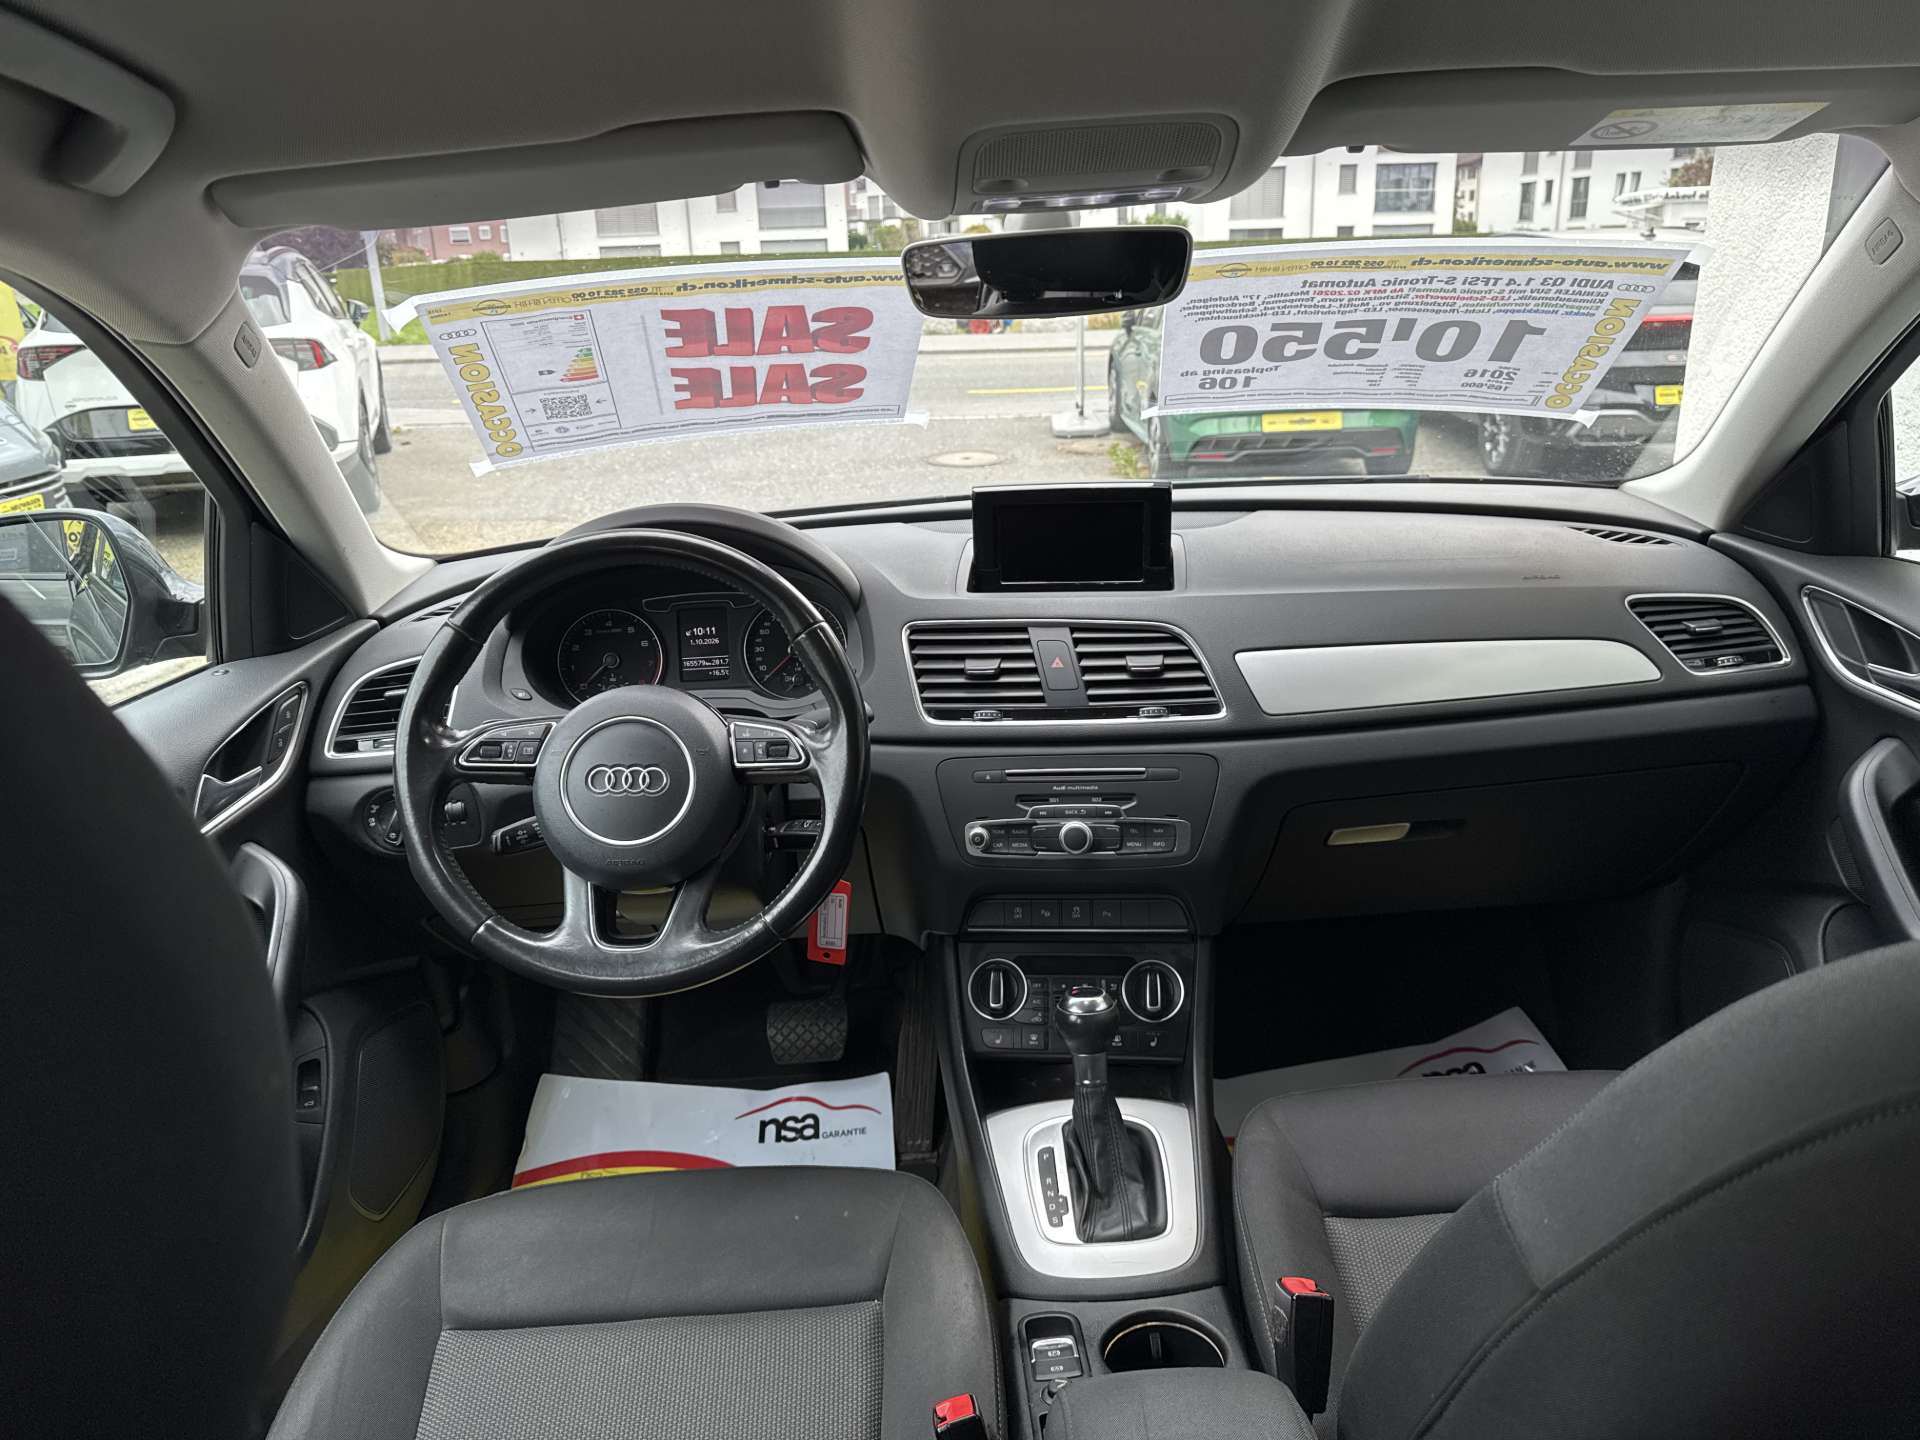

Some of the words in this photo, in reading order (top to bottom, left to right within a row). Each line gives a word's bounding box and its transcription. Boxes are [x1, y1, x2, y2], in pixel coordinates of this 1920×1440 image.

[693, 626, 716, 636] 10:11
[758, 1111, 820, 1144] nsa
[821, 1126, 868, 1140] GARANTIE
